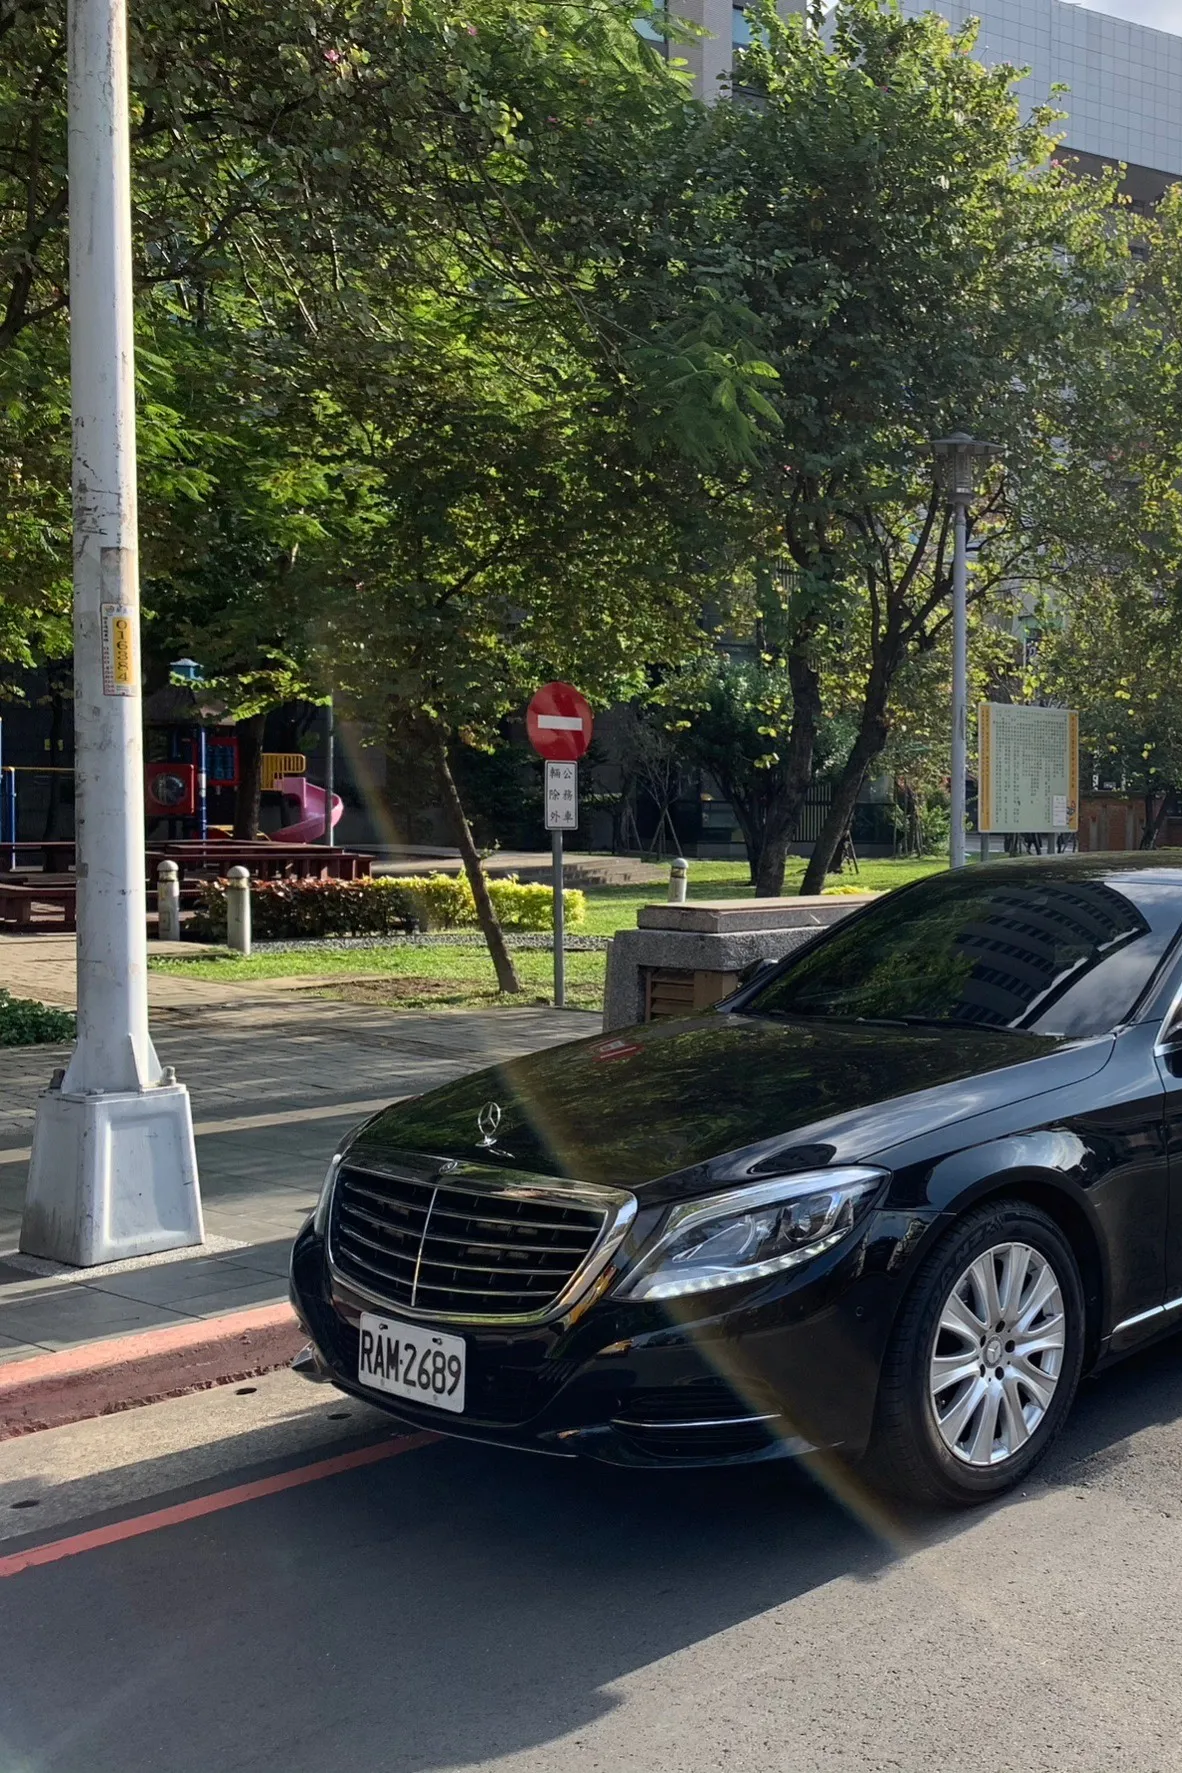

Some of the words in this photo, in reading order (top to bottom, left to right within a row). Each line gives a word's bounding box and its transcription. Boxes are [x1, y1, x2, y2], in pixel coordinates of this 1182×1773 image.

[549, 766, 560, 823] 輛除外
[563, 767, 574, 823] 公務車
